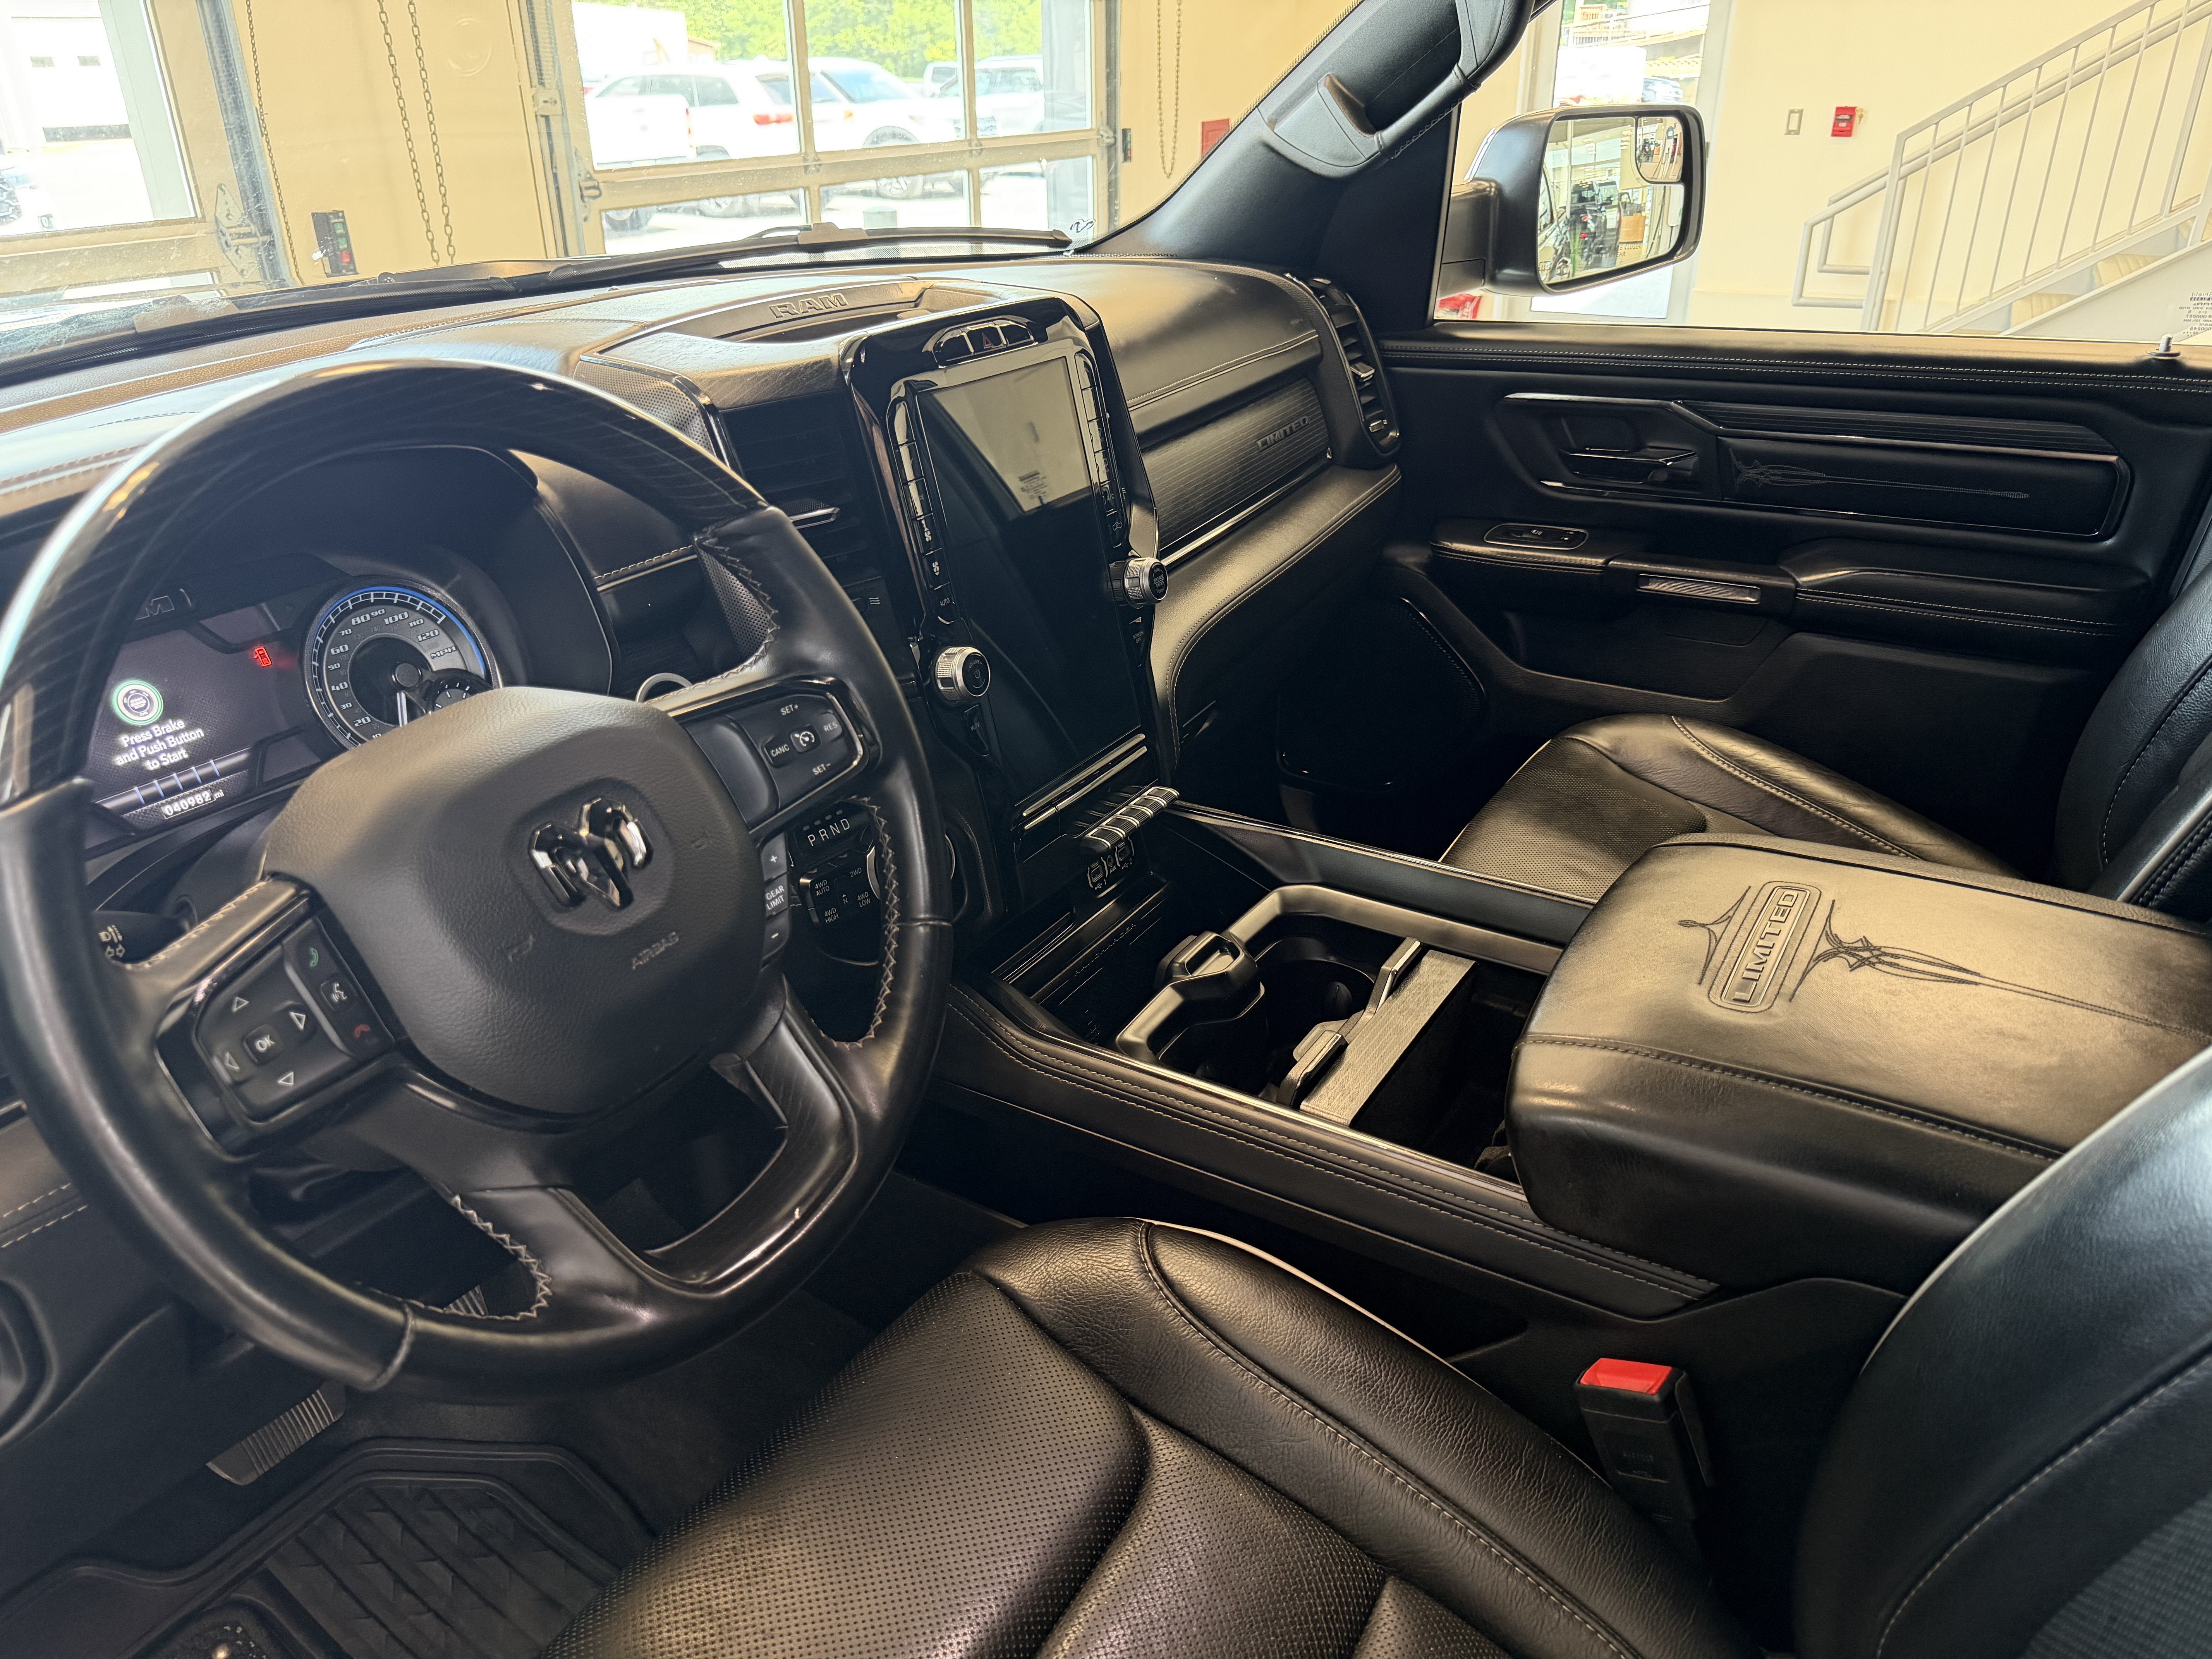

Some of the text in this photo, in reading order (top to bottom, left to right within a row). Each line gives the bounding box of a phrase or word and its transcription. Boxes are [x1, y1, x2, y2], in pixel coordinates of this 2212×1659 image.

[769, 293, 849, 318] RAM
[1256, 416, 1309, 453] LIMITED
[940, 598, 950, 607] AUTO
[351, 613, 371, 625] 80
[371, 609, 385, 618] 90
[384, 611, 409, 625] 100
[409, 619, 424, 627] 110
[417, 629, 440, 642] 120
[330, 644, 349, 655] 60
[431, 646, 457, 659] MPH
[331, 682, 348, 691] 40
[781, 704, 799, 715] SET+
[353, 716, 371, 727] 20
[823, 721, 838, 732] RES
[122, 719, 185, 747] Press Brake
[116, 728, 204, 766] and Push Button
[771, 744, 790, 757] CANC
[146, 749, 189, 770] to Start
[164, 790, 225, 815] 040982 mi
[850, 867, 862, 878] 2WD
[815, 879, 828, 890] 4WD
[766, 885, 785, 900] GEAR
[816, 885, 830, 897] AUTO
[857, 891, 869, 902] 4WD
[766, 895, 785, 910] LIMIT
[859, 897, 871, 908] LOW
[824, 907, 837, 917] 4WD
[825, 914, 839, 924] HIGH
[632, 931, 679, 970] AIRBAG
[1733, 891, 1799, 1002] LIMITED
[256, 1034, 275, 1052] OK
